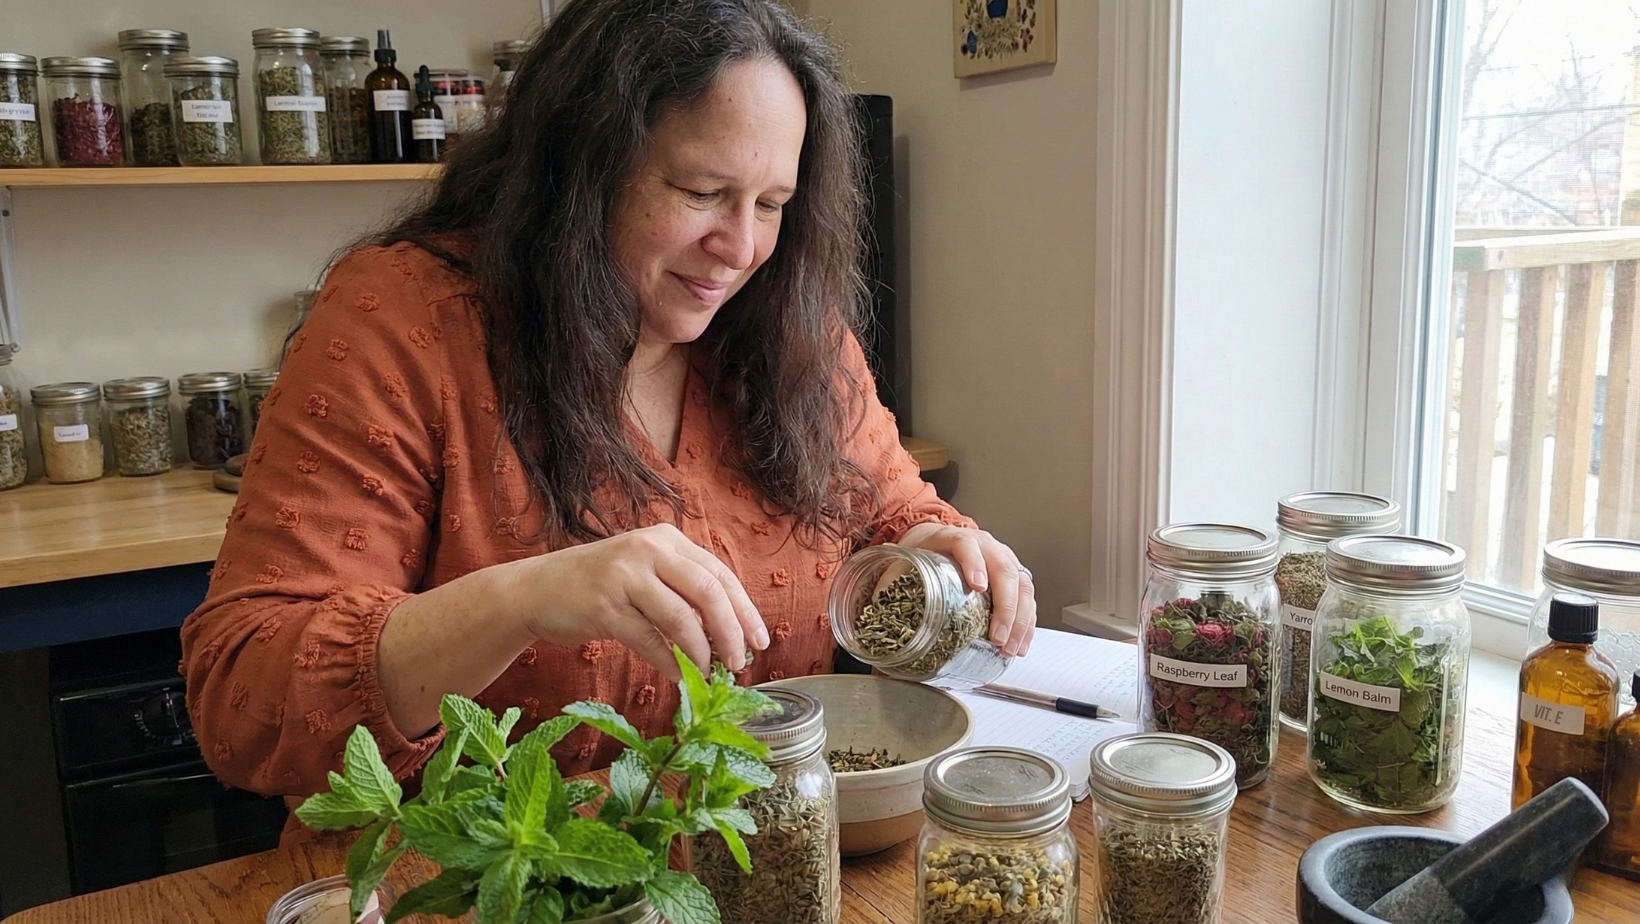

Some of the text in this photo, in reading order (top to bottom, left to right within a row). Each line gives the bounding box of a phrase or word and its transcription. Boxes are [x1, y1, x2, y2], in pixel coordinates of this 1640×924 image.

[1289, 611, 1313, 625] Yarro
[1157, 661, 1239, 682] Raspberry Leaf
[1325, 680, 1392, 705] Lemon Balm
[1534, 703, 1564, 725] VIT. E
